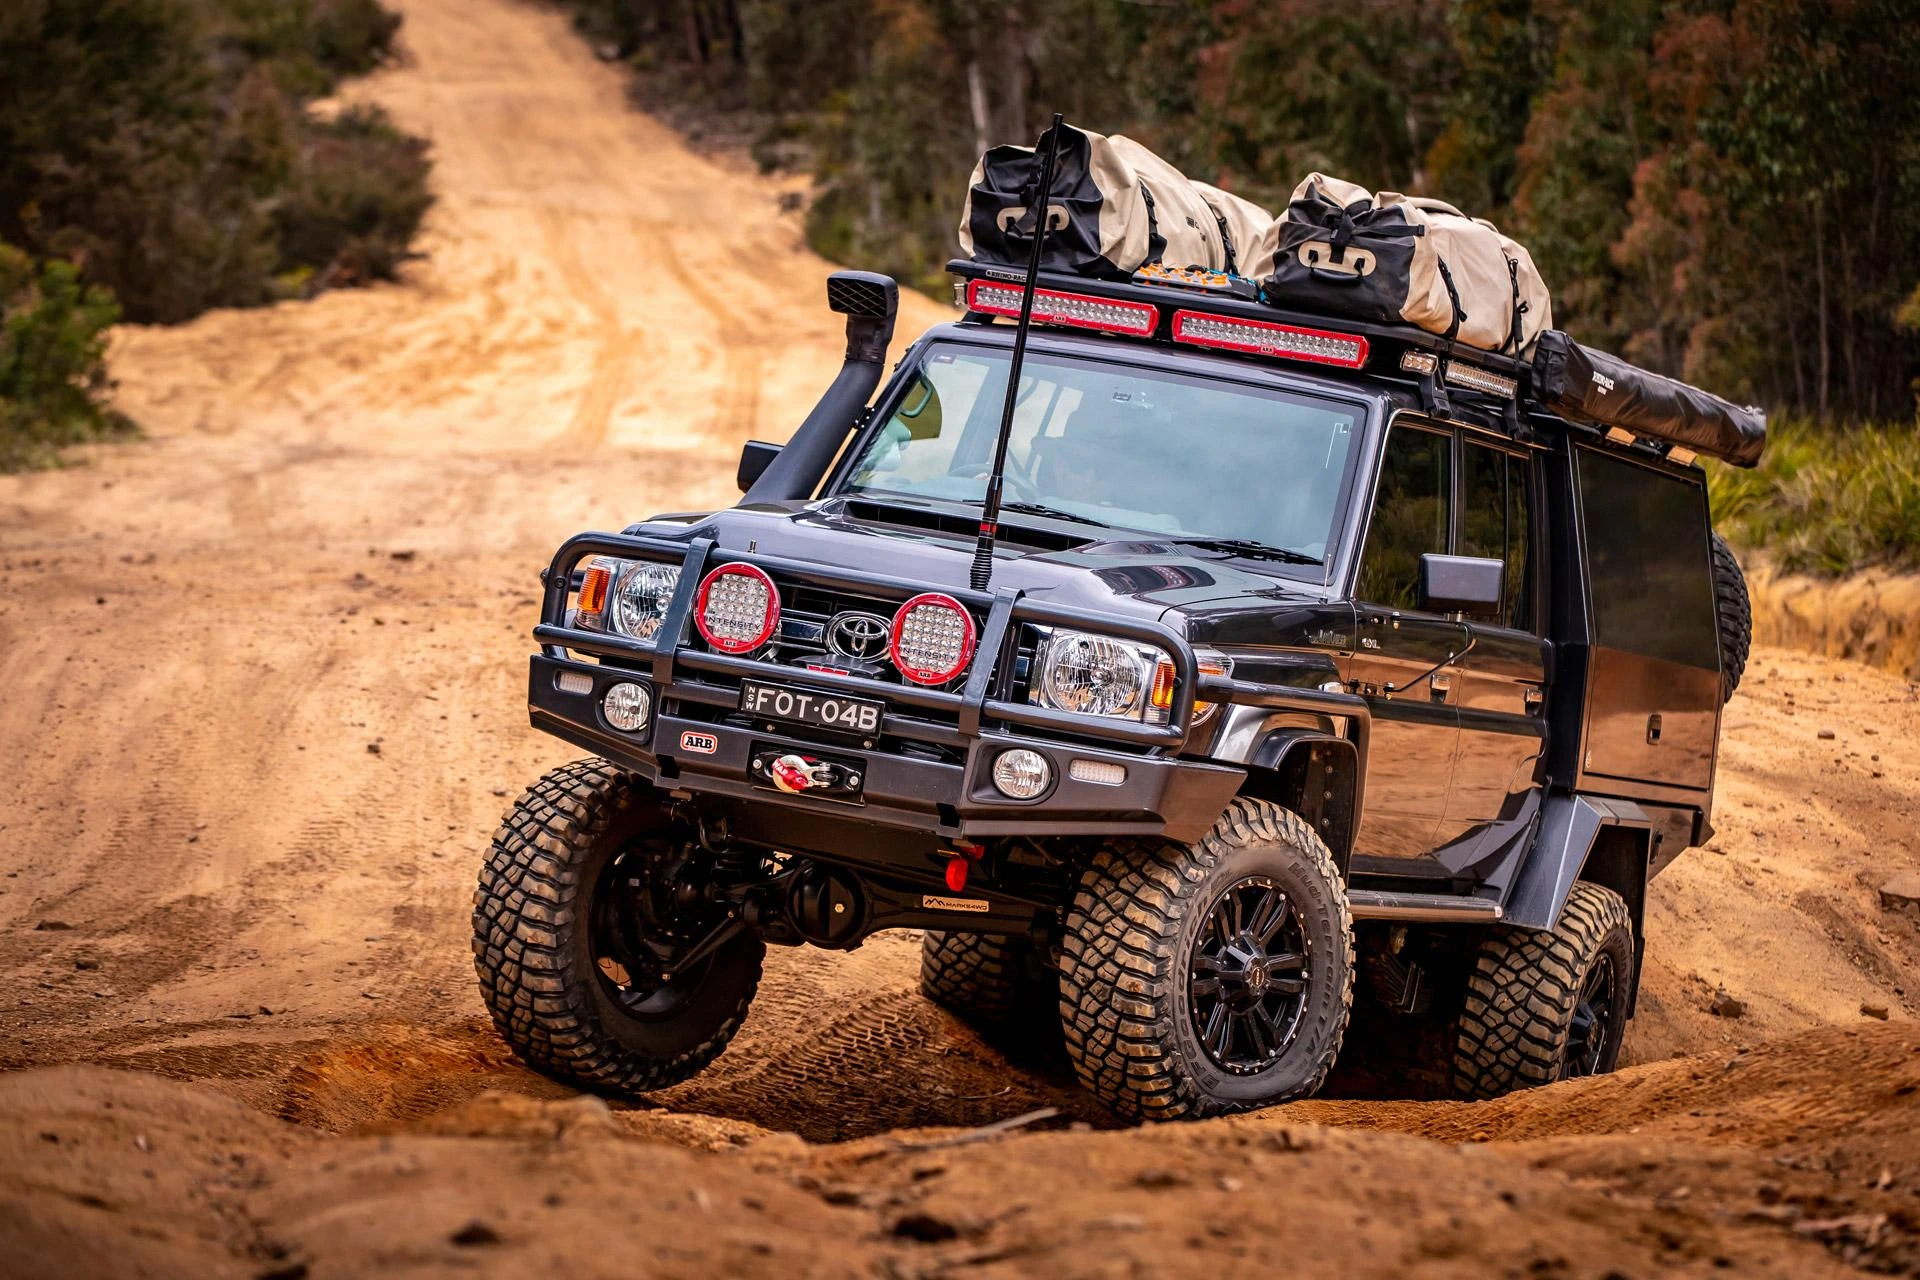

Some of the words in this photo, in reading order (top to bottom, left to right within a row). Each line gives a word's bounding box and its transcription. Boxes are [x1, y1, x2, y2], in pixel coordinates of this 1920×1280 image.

[990, 269, 1028, 282] RHINO-RAC
[685, 735, 713, 749] ARB
[772, 758, 789, 776] WAR
